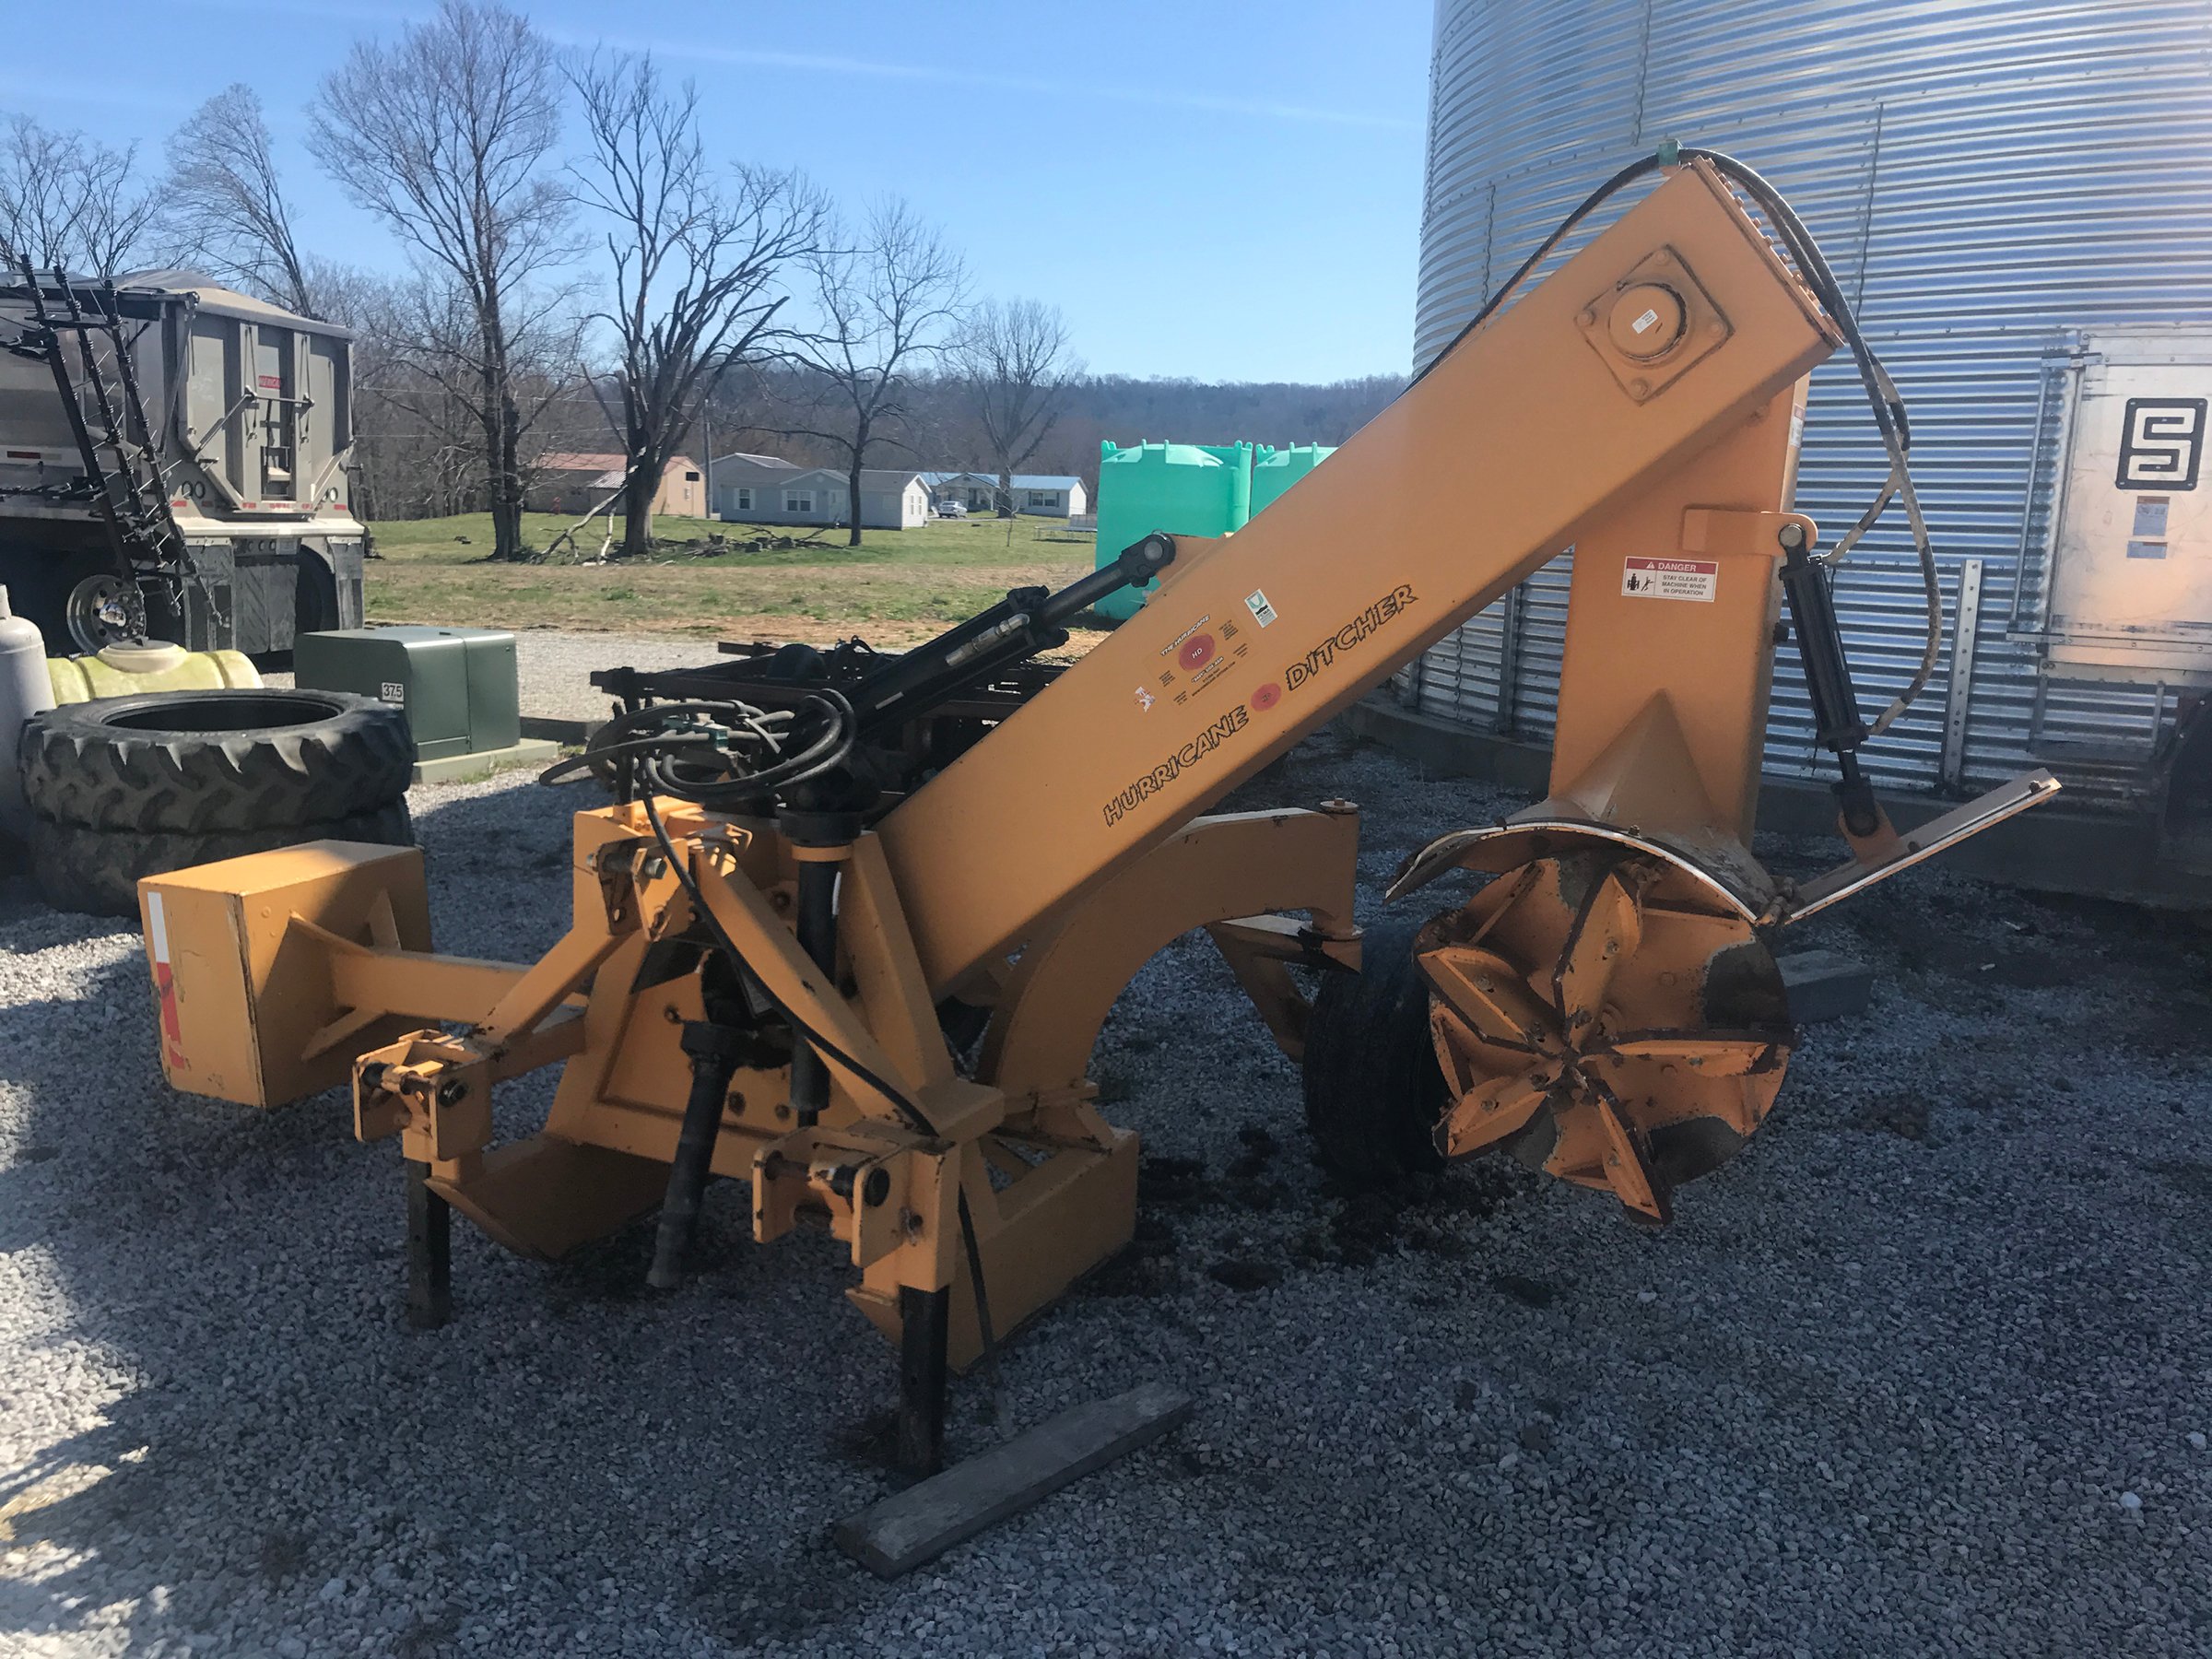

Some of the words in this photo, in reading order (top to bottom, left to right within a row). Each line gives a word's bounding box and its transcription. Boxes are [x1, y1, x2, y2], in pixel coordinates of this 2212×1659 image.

[1658, 562, 1697, 572] DANGER
[1160, 642, 1175, 656] THE
[1173, 614, 1210, 646] HURRICANE
[1191, 647, 1203, 659] HD
[1103, 705, 1249, 827] HURRICANE
[1286, 583, 1419, 691] DITCHER
